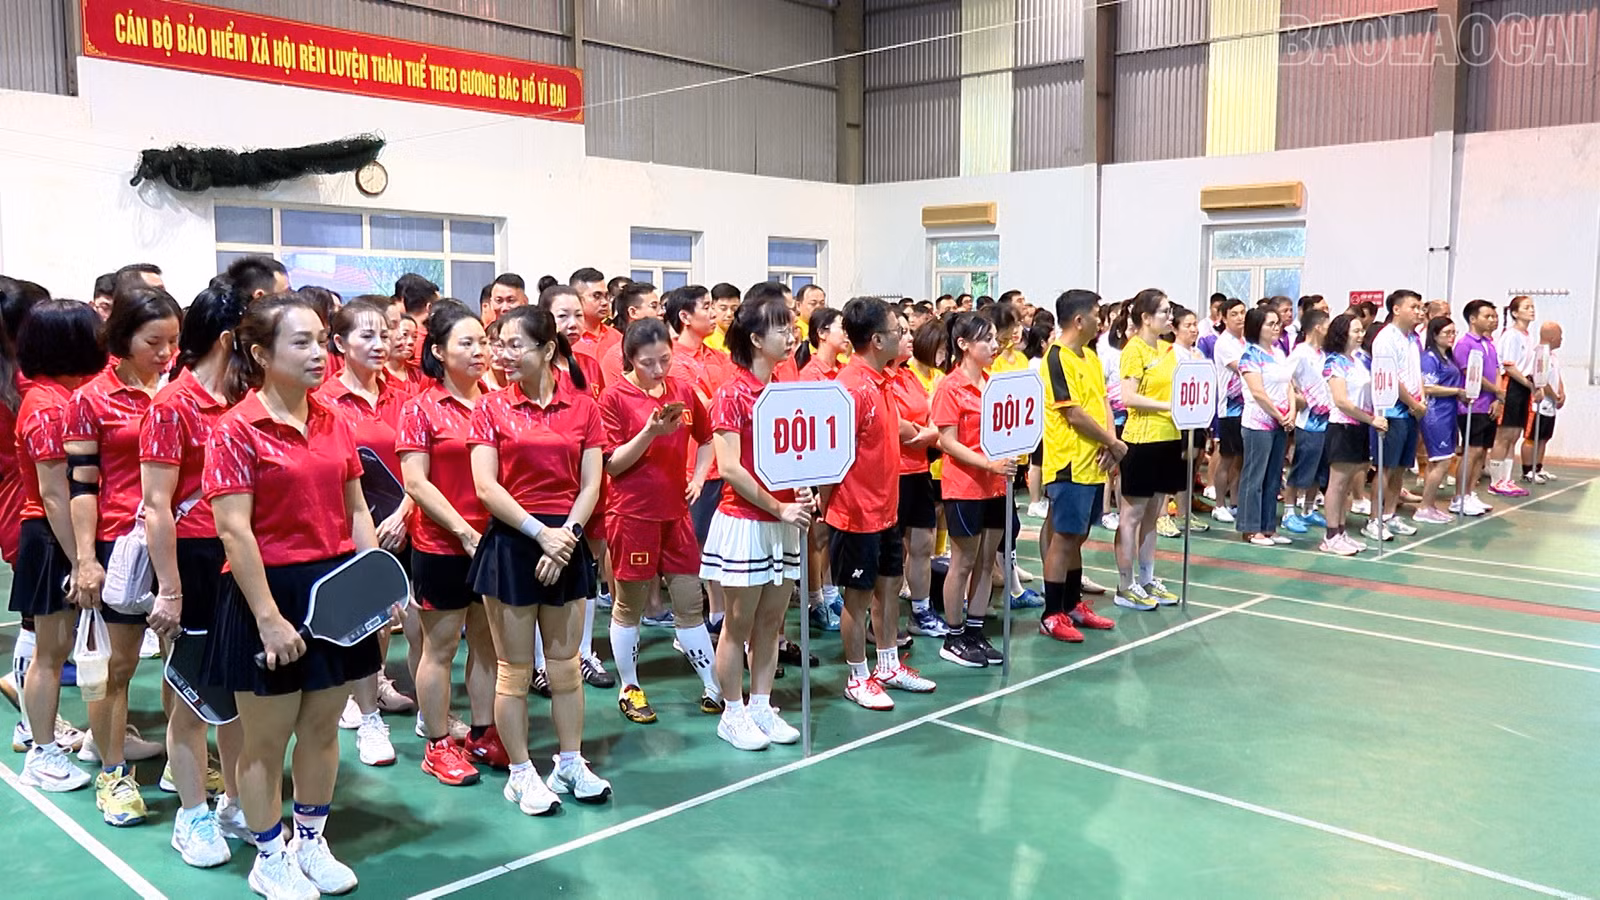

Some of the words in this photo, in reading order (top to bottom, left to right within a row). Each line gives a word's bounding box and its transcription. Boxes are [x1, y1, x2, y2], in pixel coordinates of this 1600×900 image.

[114, 9, 148, 47] CÁN
[152, 15, 174, 57] BỘ
[177, 13, 207, 56] BẢO
[211, 20, 248, 62] HIỂM
[251, 32, 270, 65] XÃ
[274, 35, 297, 75] HỘI
[300, 40, 326, 74] RÈN
[329, 47, 368, 85] LUYỆN
[371, 52, 403, 86] THÂN
[405, 53, 427, 89] THỂ
[429, 64, 458, 94] THEO
[460, 68, 497, 99] GƯƠNG
[498, 72, 520, 102] BÁC
[538, 77, 548, 105] VĨ
[550, 82, 567, 112] ĐẠI
[992, 394, 1020, 436] ĐỘI
[1025, 397, 1035, 426] 2
[1180, 376, 1200, 411] ĐỘI
[1203, 381, 1210, 405] 3
[773, 408, 816, 461] ĐỘI
[826, 415, 837, 449] 1
